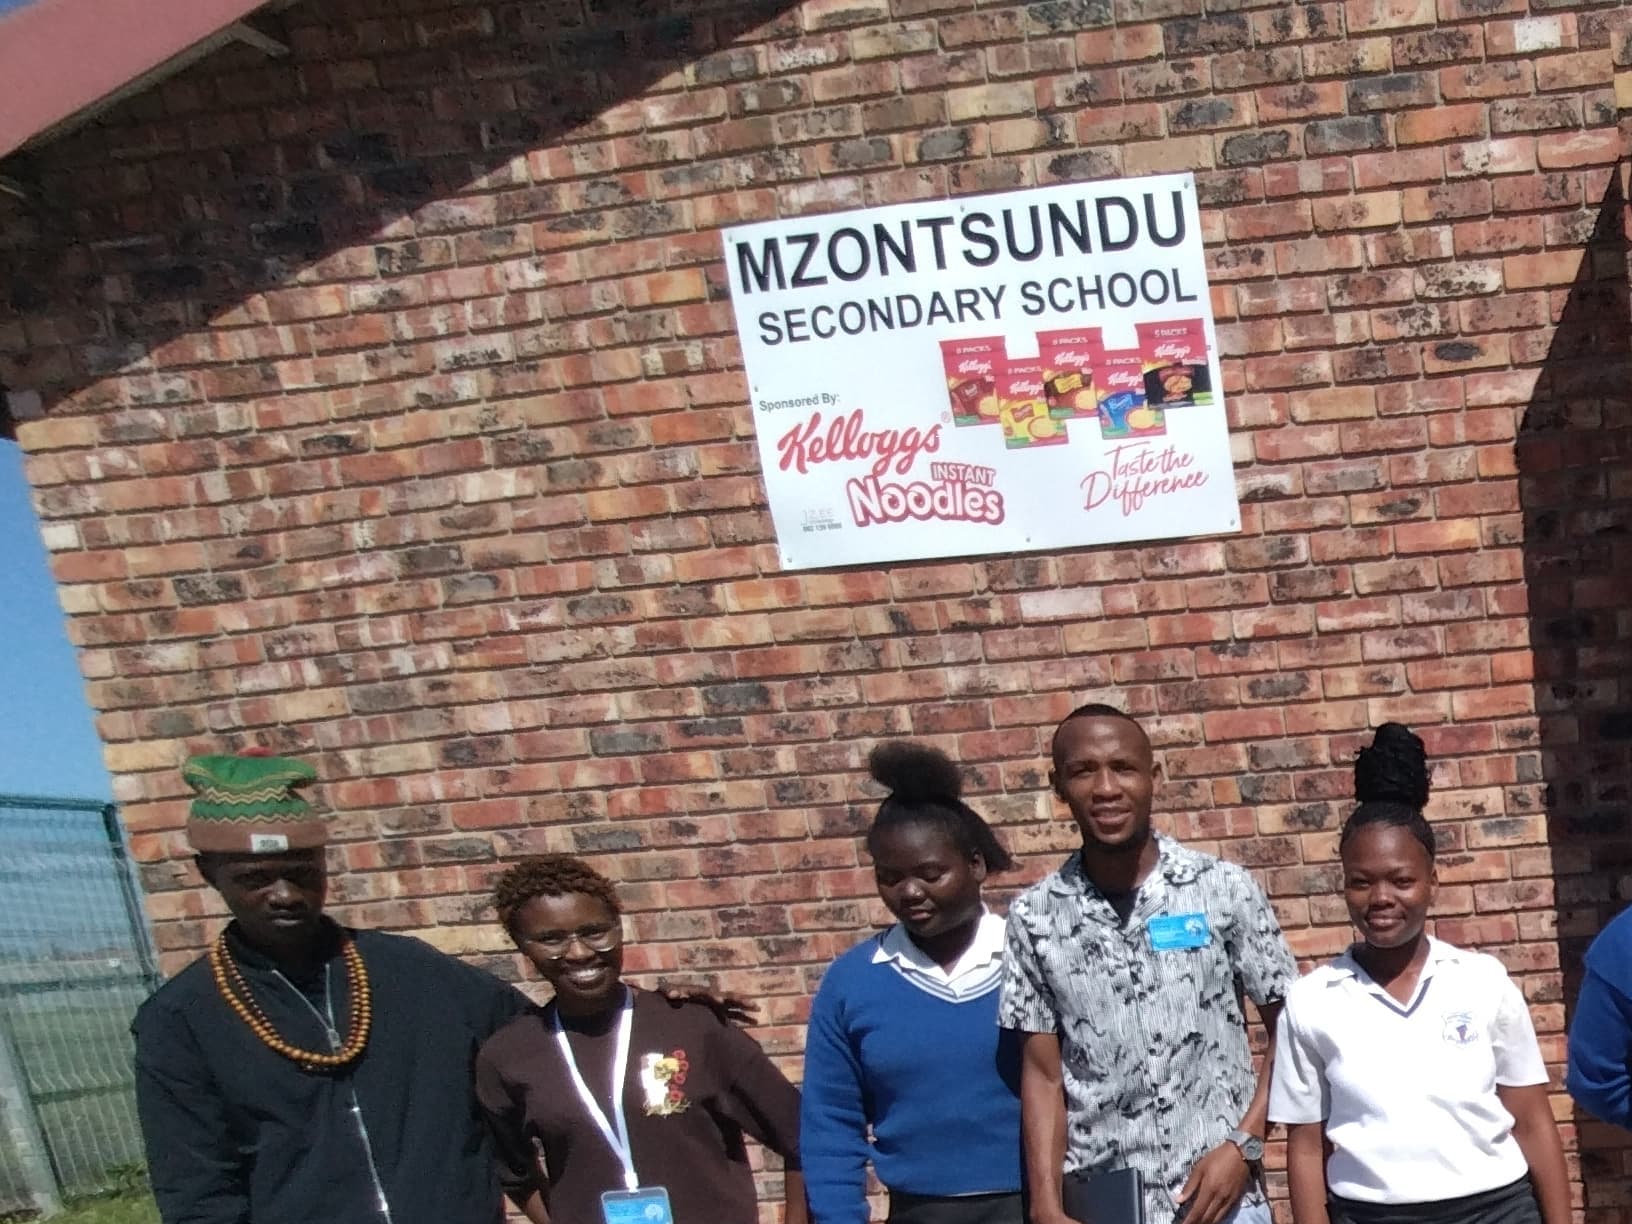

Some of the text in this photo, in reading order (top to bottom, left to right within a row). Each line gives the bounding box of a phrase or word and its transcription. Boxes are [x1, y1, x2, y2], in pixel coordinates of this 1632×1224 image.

[736, 189, 1187, 294] MZONTSUNDU
[758, 267, 1198, 346] SECONDARY SCHOOL
[759, 393, 841, 412] Sponsored By:
[931, 463, 996, 485] INSTANT
[1104, 441, 1194, 480] Taste the
[848, 475, 1004, 527] Noodles
[1080, 470, 1209, 517] Difference
